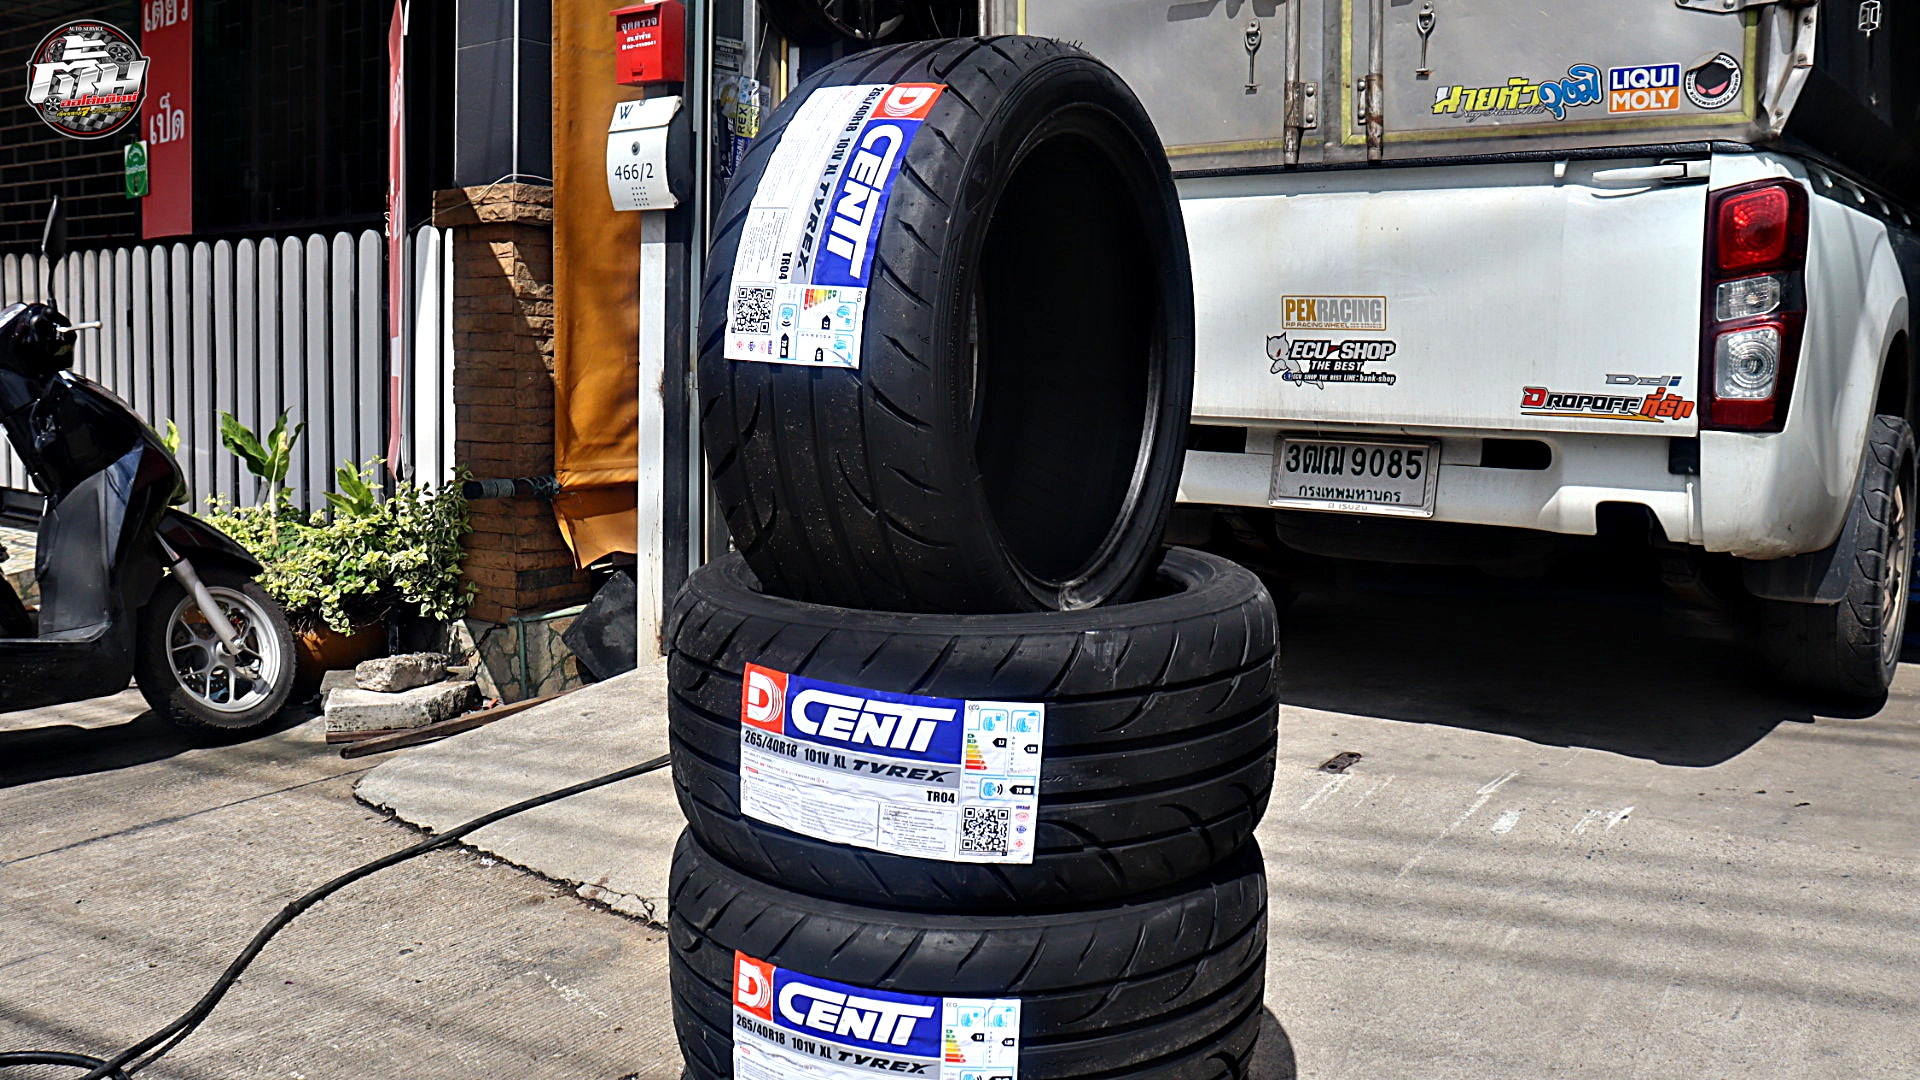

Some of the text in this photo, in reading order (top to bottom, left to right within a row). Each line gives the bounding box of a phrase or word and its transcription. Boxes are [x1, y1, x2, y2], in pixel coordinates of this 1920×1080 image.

[1613, 67, 1675, 89] LIQUI
[1612, 89, 1675, 111] MOLY
[150, 92, 185, 145] เป็ด
[737, 107, 748, 134] REX
[615, 163, 654, 182] 466/2
[797, 87, 885, 281] 265/40R18 101V XL TYREX
[778, 252, 792, 280] TR04
[1291, 341, 1395, 360] ECU SHOP
[1311, 360, 1363, 371] THE BEST
[1522, 387, 1643, 413] DROPOFF
[1351, 447, 1424, 480] 9085
[1339, 503, 1368, 511] ISUZU
[744, 730, 798, 758] 265/40R18
[804, 747, 830, 766] 101V
[833, 755, 847, 769] XL
[853, 759, 955, 783] TYREX
[926, 790, 955, 804] TR04
[736, 1014, 786, 1045] 265/40R18
[792, 1037, 816, 1055] 101V
[820, 1045, 832, 1060] XL
[838, 1050, 936, 1075] TYREX
